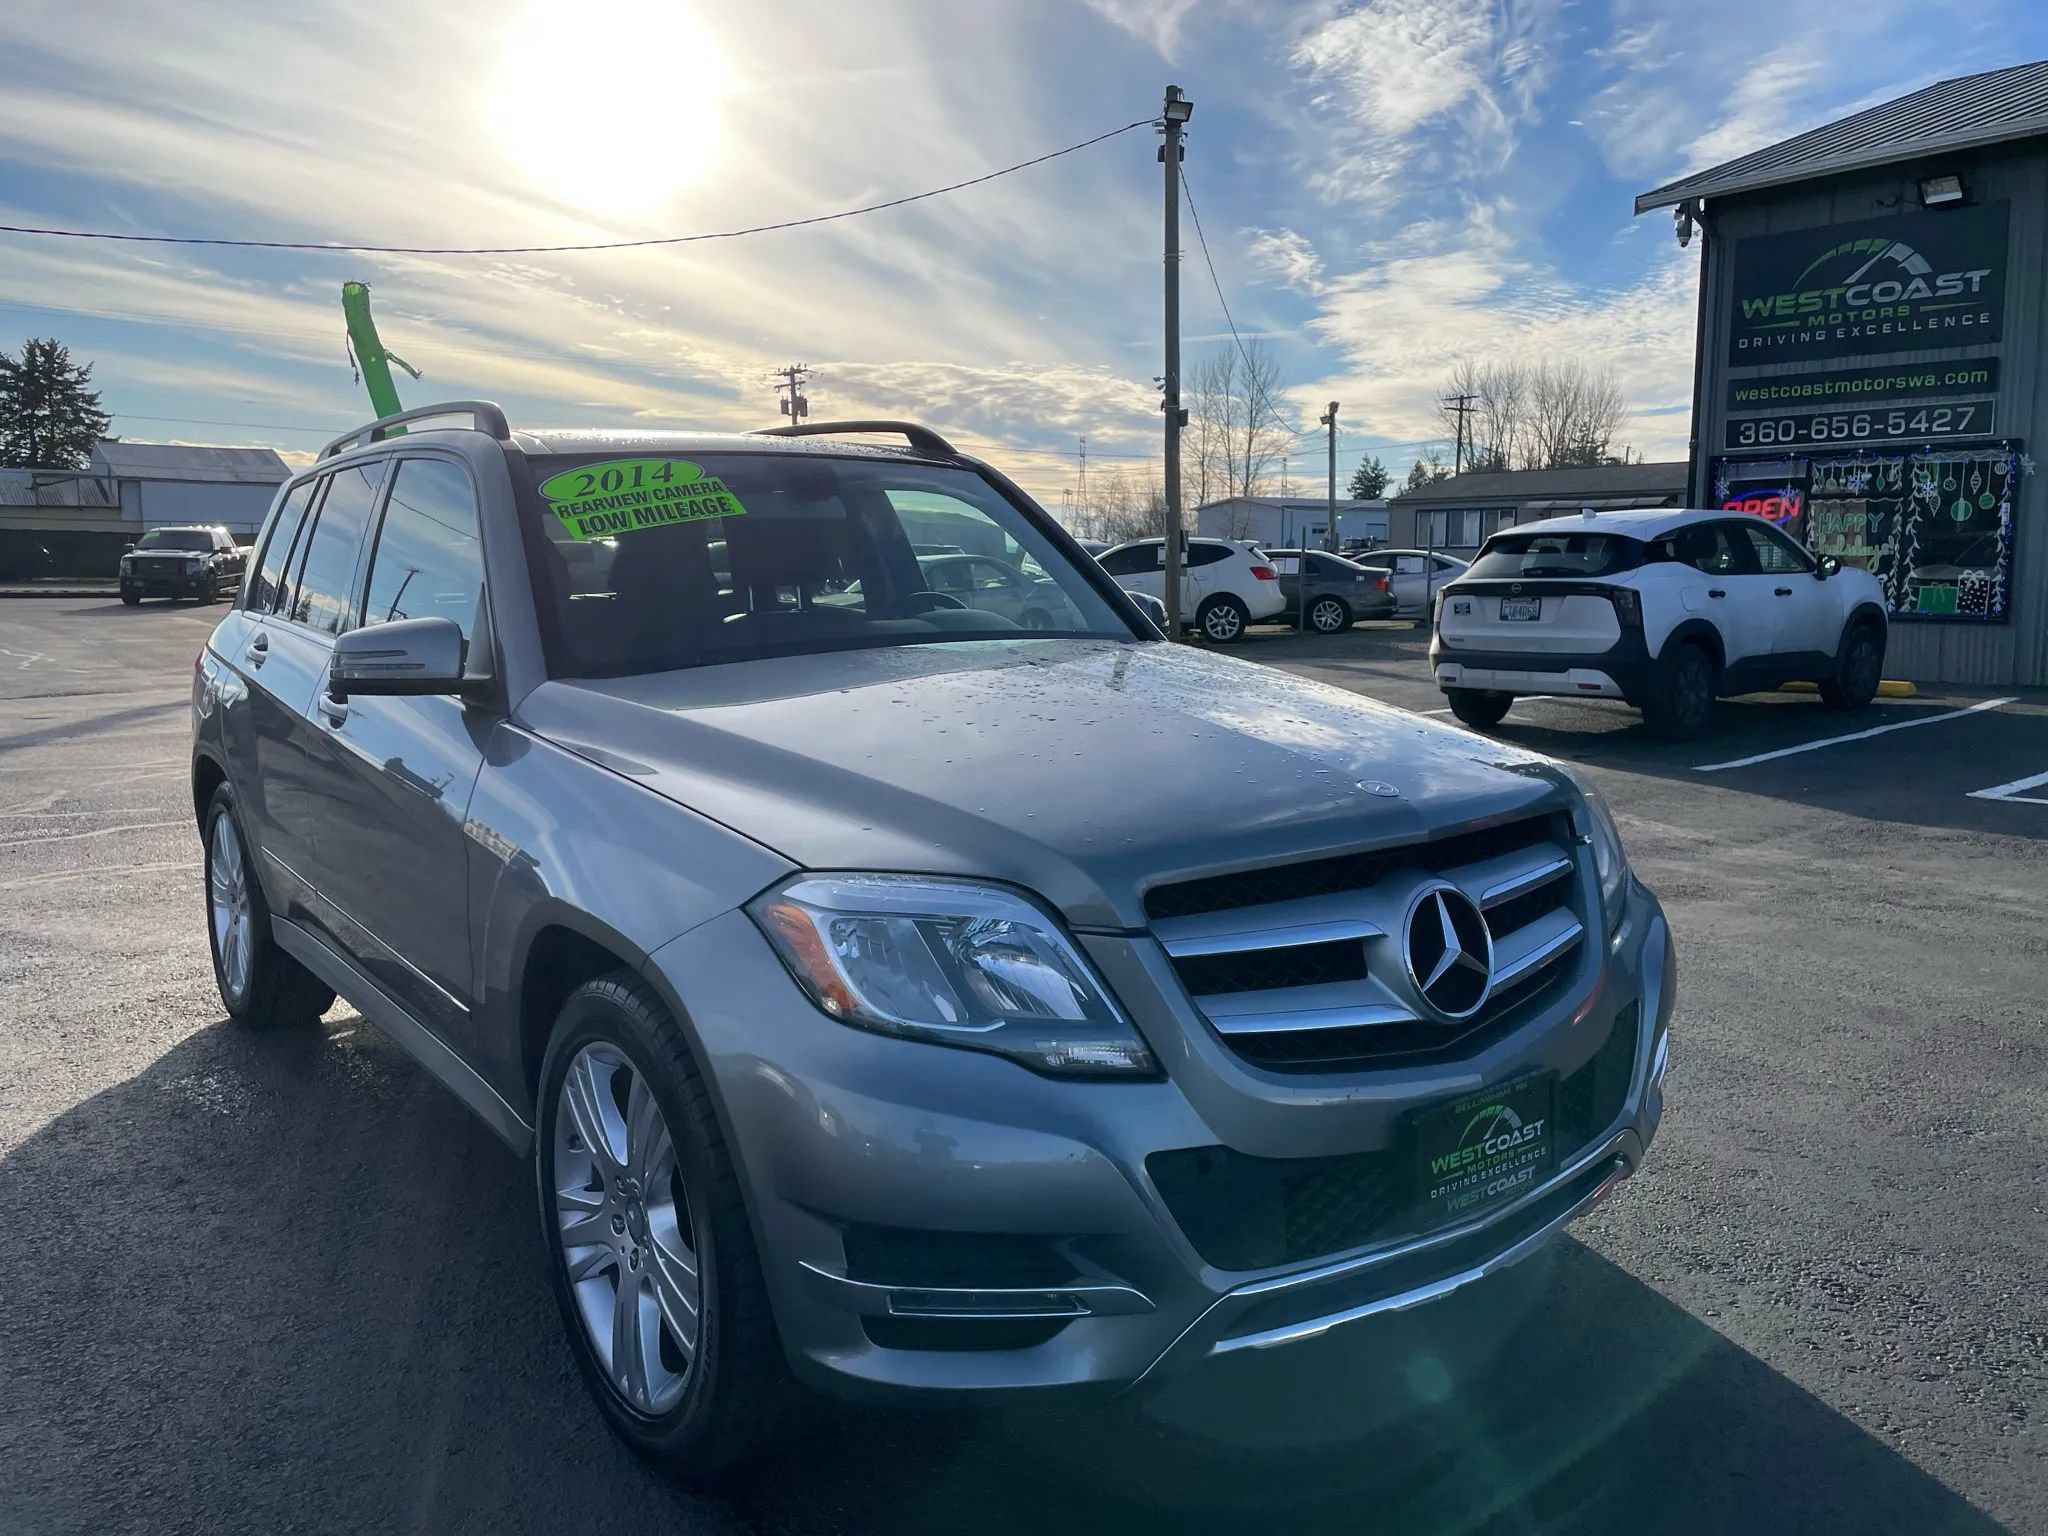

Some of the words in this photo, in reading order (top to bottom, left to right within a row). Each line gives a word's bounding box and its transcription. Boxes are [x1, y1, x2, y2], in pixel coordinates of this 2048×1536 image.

[1742, 269, 1992, 319] WESTCOAST
[1739, 330, 1826, 349] DRIVING
[1836, 312, 1991, 338] EXCELLENCE
[1808, 304, 1910, 327] MOTORS
[1736, 369, 1988, 401] westcoastmotorswa.com
[1739, 406, 1976, 445] 360-656-5427
[573, 462, 674, 498] 2014
[557, 490, 649, 519] REARVIEW
[653, 480, 725, 501] CAMERA
[576, 510, 630, 536] LOW
[631, 496, 734, 526] MILEAGE
[1722, 496, 1800, 520] OPEN
[1819, 511, 1885, 534] HAPPY
[1431, 1119, 1545, 1175] WESTCOAST
[1466, 1150, 1515, 1174] MOTORS
[1430, 1175, 1478, 1199] DRIVING
[1481, 1146, 1547, 1180] EXCELLENCE
